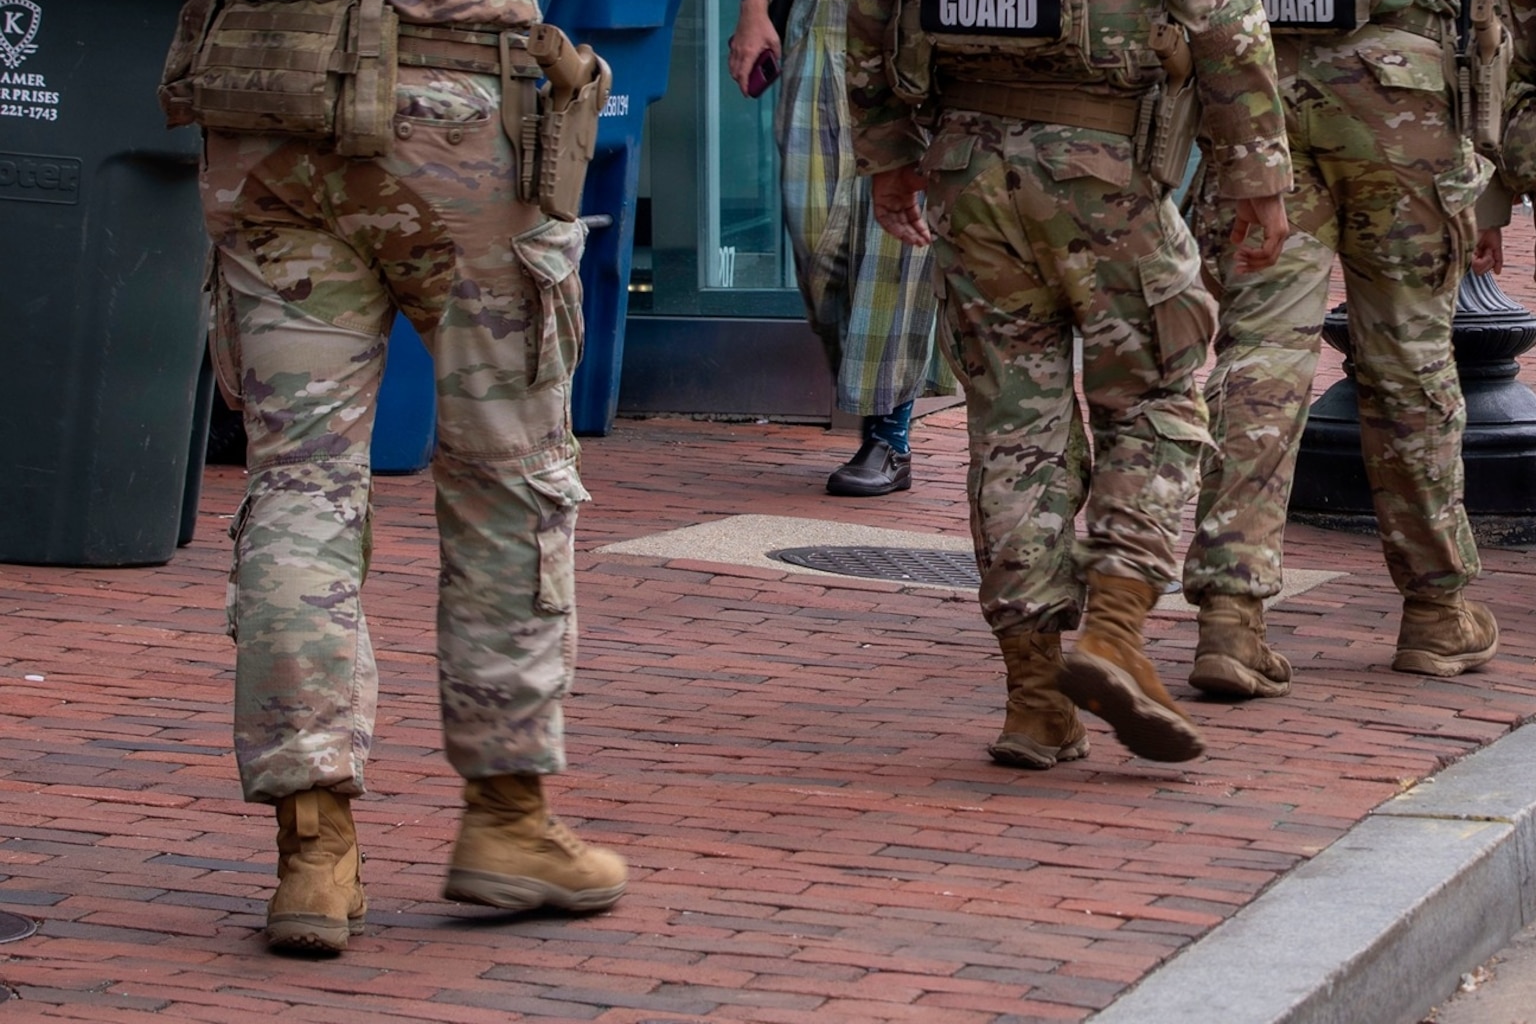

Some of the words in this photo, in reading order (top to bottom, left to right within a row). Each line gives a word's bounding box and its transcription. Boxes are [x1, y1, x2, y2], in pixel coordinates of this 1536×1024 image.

[5, 10, 25, 36] K
[0, 71, 46, 88] AMER
[0, 87, 60, 104] RPRISES
[0, 104, 58, 121] 221-1743
